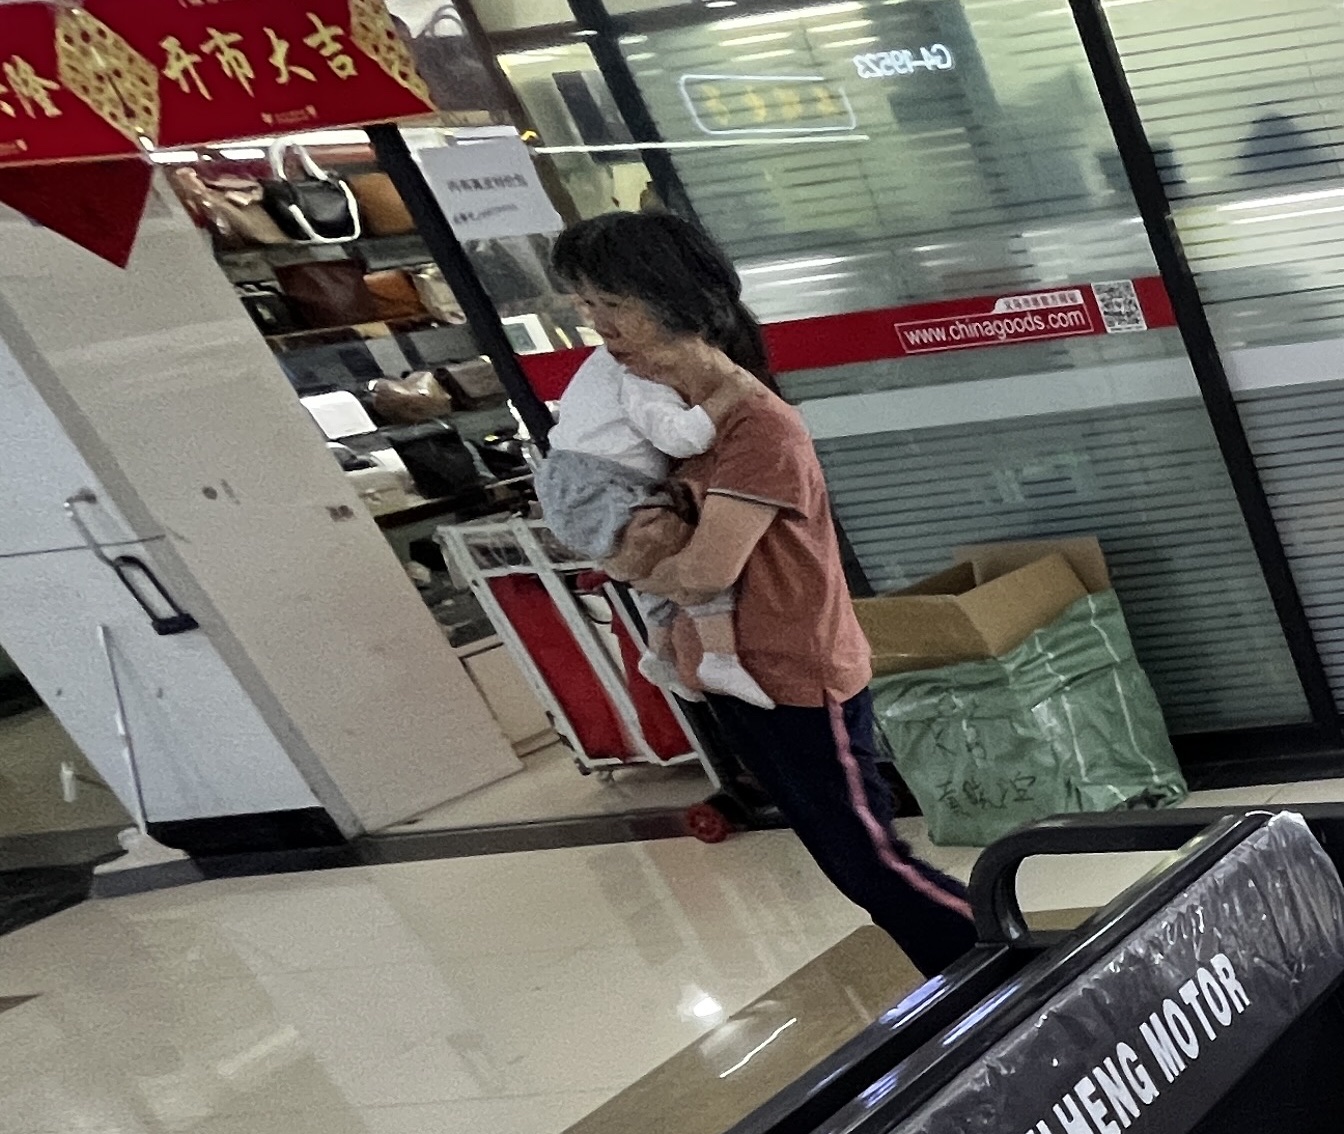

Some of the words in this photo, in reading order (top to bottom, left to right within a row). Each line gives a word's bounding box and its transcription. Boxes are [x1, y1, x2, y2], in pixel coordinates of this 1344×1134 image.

[0, 55, 62, 119] 隆
[160, 12, 358, 100] 开市大吉
[903, 308, 1087, 346] www.chinagoods.com
[1139, 953, 1251, 1083] MOTOR
